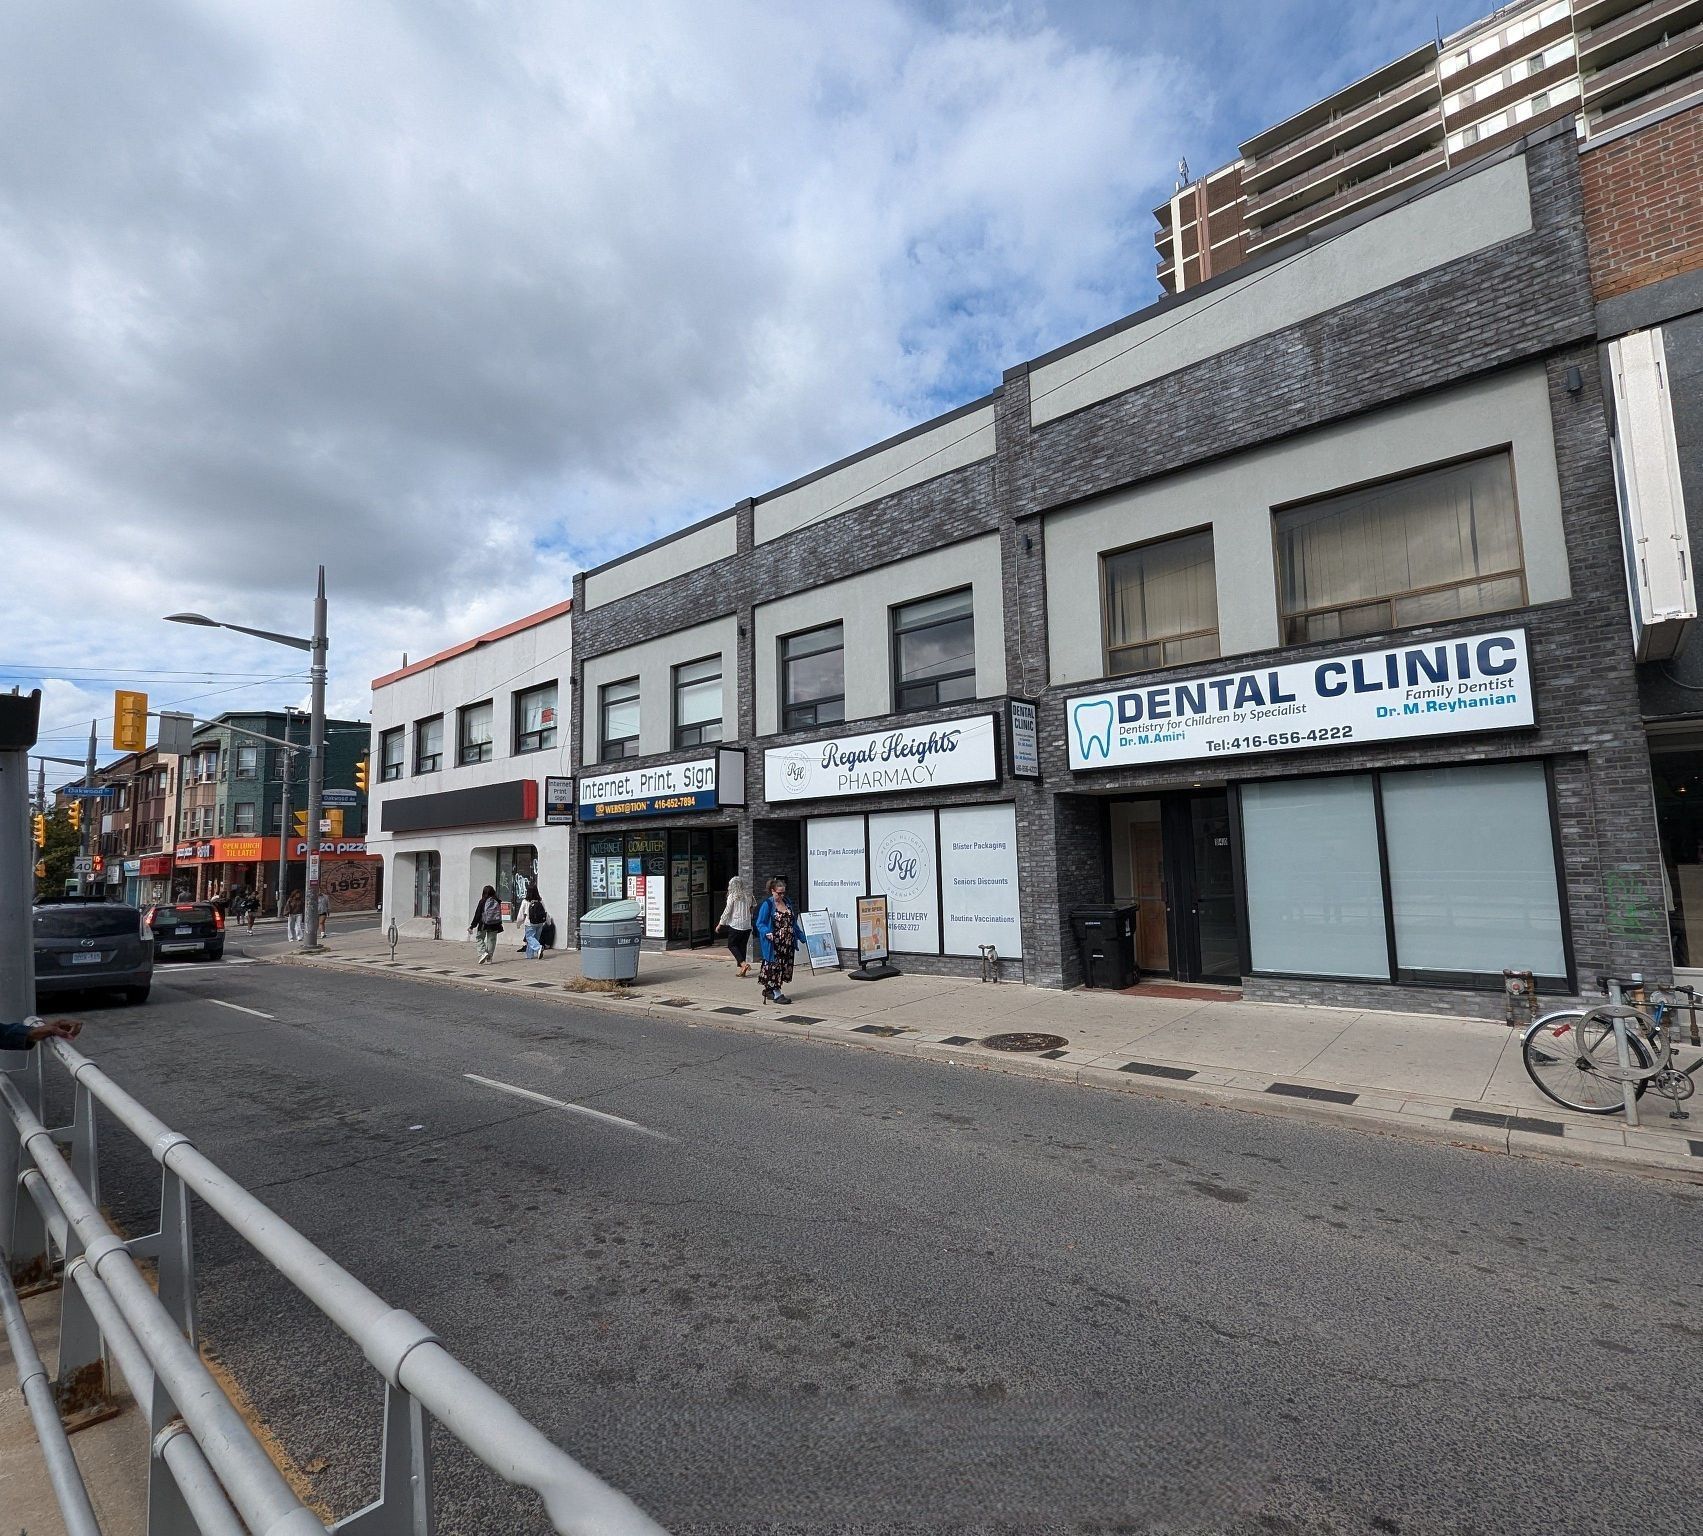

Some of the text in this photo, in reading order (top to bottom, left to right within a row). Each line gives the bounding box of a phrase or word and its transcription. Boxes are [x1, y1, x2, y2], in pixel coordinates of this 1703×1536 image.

[1117, 636, 1517, 724] DENTAL CLINIC
[1405, 677, 1514, 701] Family Dentist
[1012, 704, 1035, 719] DENTAL
[1376, 693, 1517, 718] Dr. M.Reyhanian
[1014, 717, 1034, 731] CLINIC
[1119, 703, 1307, 736] Dentistry for Children by Specialist
[1119, 731, 1186, 747] Dr. M.Amiri
[1206, 725, 1353, 752] Tel:416-656-4222
[821, 740, 877, 772] Regal
[881, 729, 961, 764] Heights
[548, 780, 572, 788] Internet
[582, 766, 714, 800] Internet, Print, Sign
[838, 764, 937, 791] PHARMACY
[605, 801, 647, 814] WEBST@TION
[222, 842, 239, 850] OPEN
[297, 843, 335, 855] pza
[628, 840, 665, 852] COMPUTER
[842, 848, 864, 856] Accepted
[952, 841, 1007, 850] Blister Packaging
[76, 863, 91, 871] 40
[330, 876, 370, 894] 1967
[813, 879, 861, 887] Medication Reviews
[953, 877, 1009, 885] Seniors Discounts
[887, 912, 928, 921] EE DELIVERY
[950, 914, 1015, 923] Routine Vaccinations
